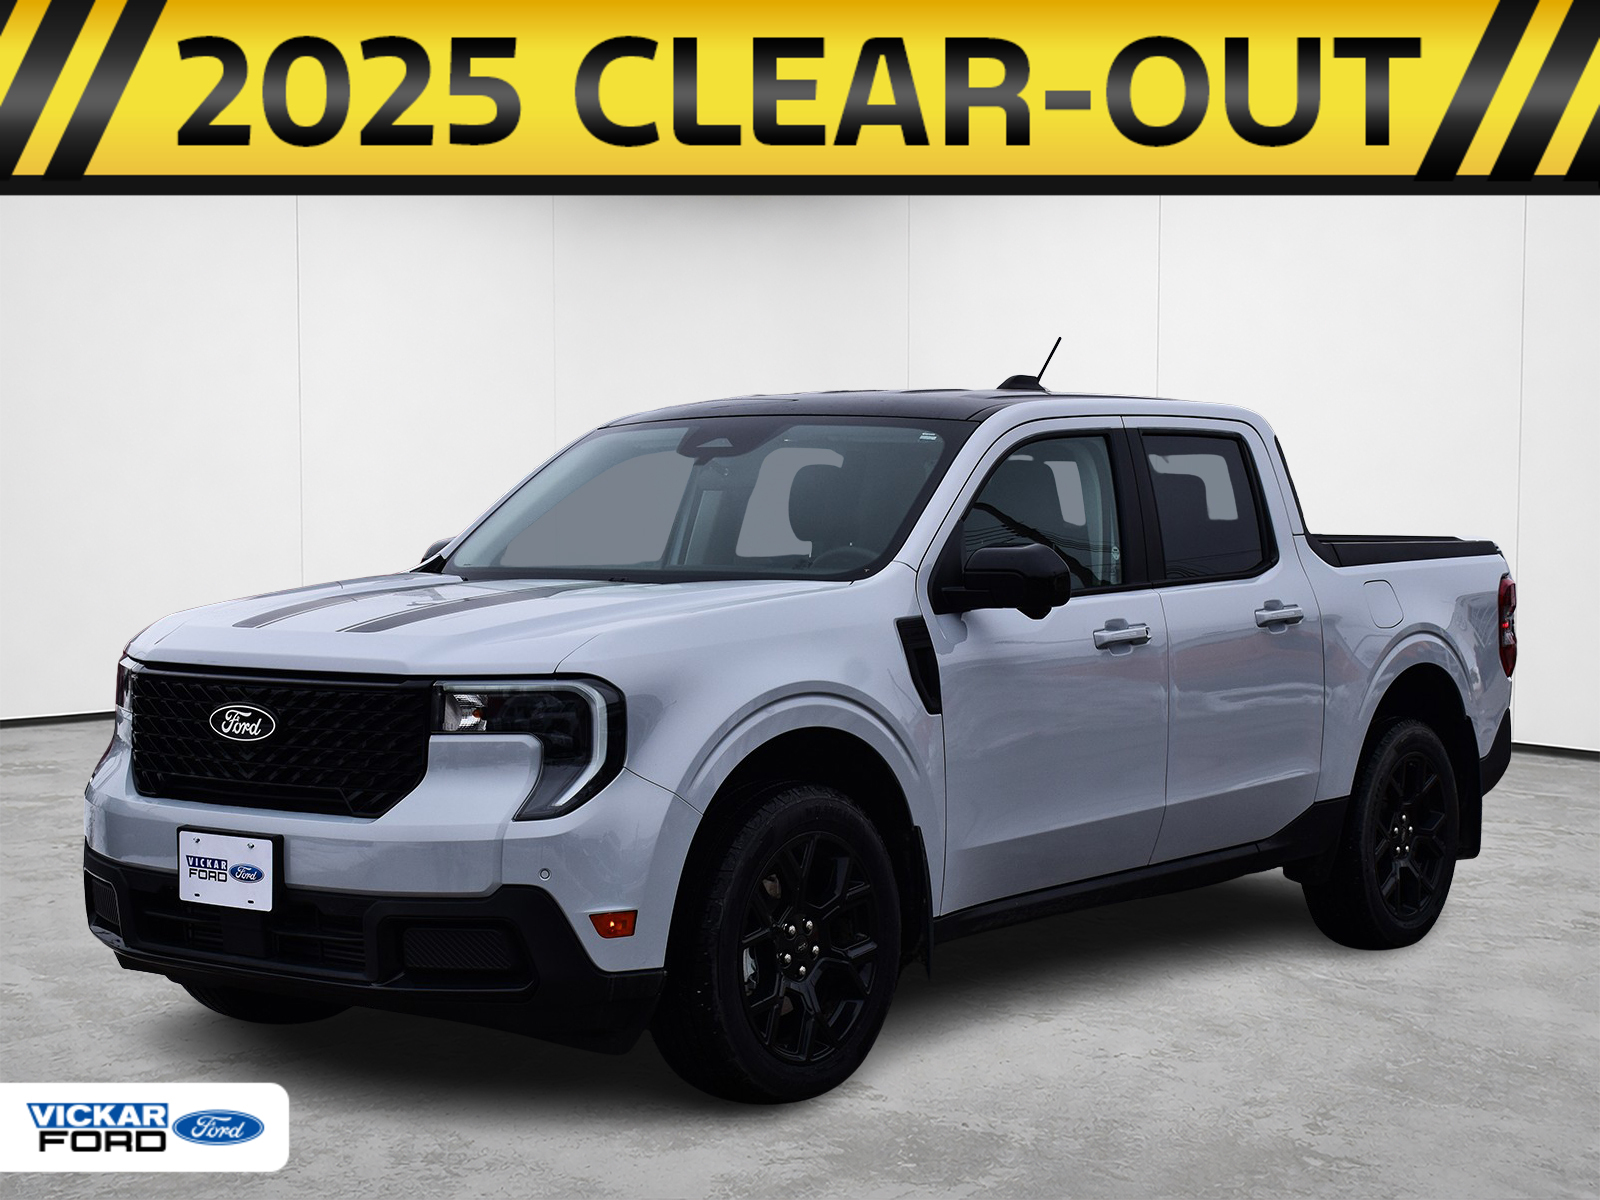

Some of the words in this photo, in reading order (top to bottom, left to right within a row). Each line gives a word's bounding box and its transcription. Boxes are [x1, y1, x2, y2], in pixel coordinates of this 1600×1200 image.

[221, 709, 262, 736] Ford
[187, 856, 228, 870] VICKAR
[189, 868, 228, 883] FORD
[236, 867, 258, 882] Ford
